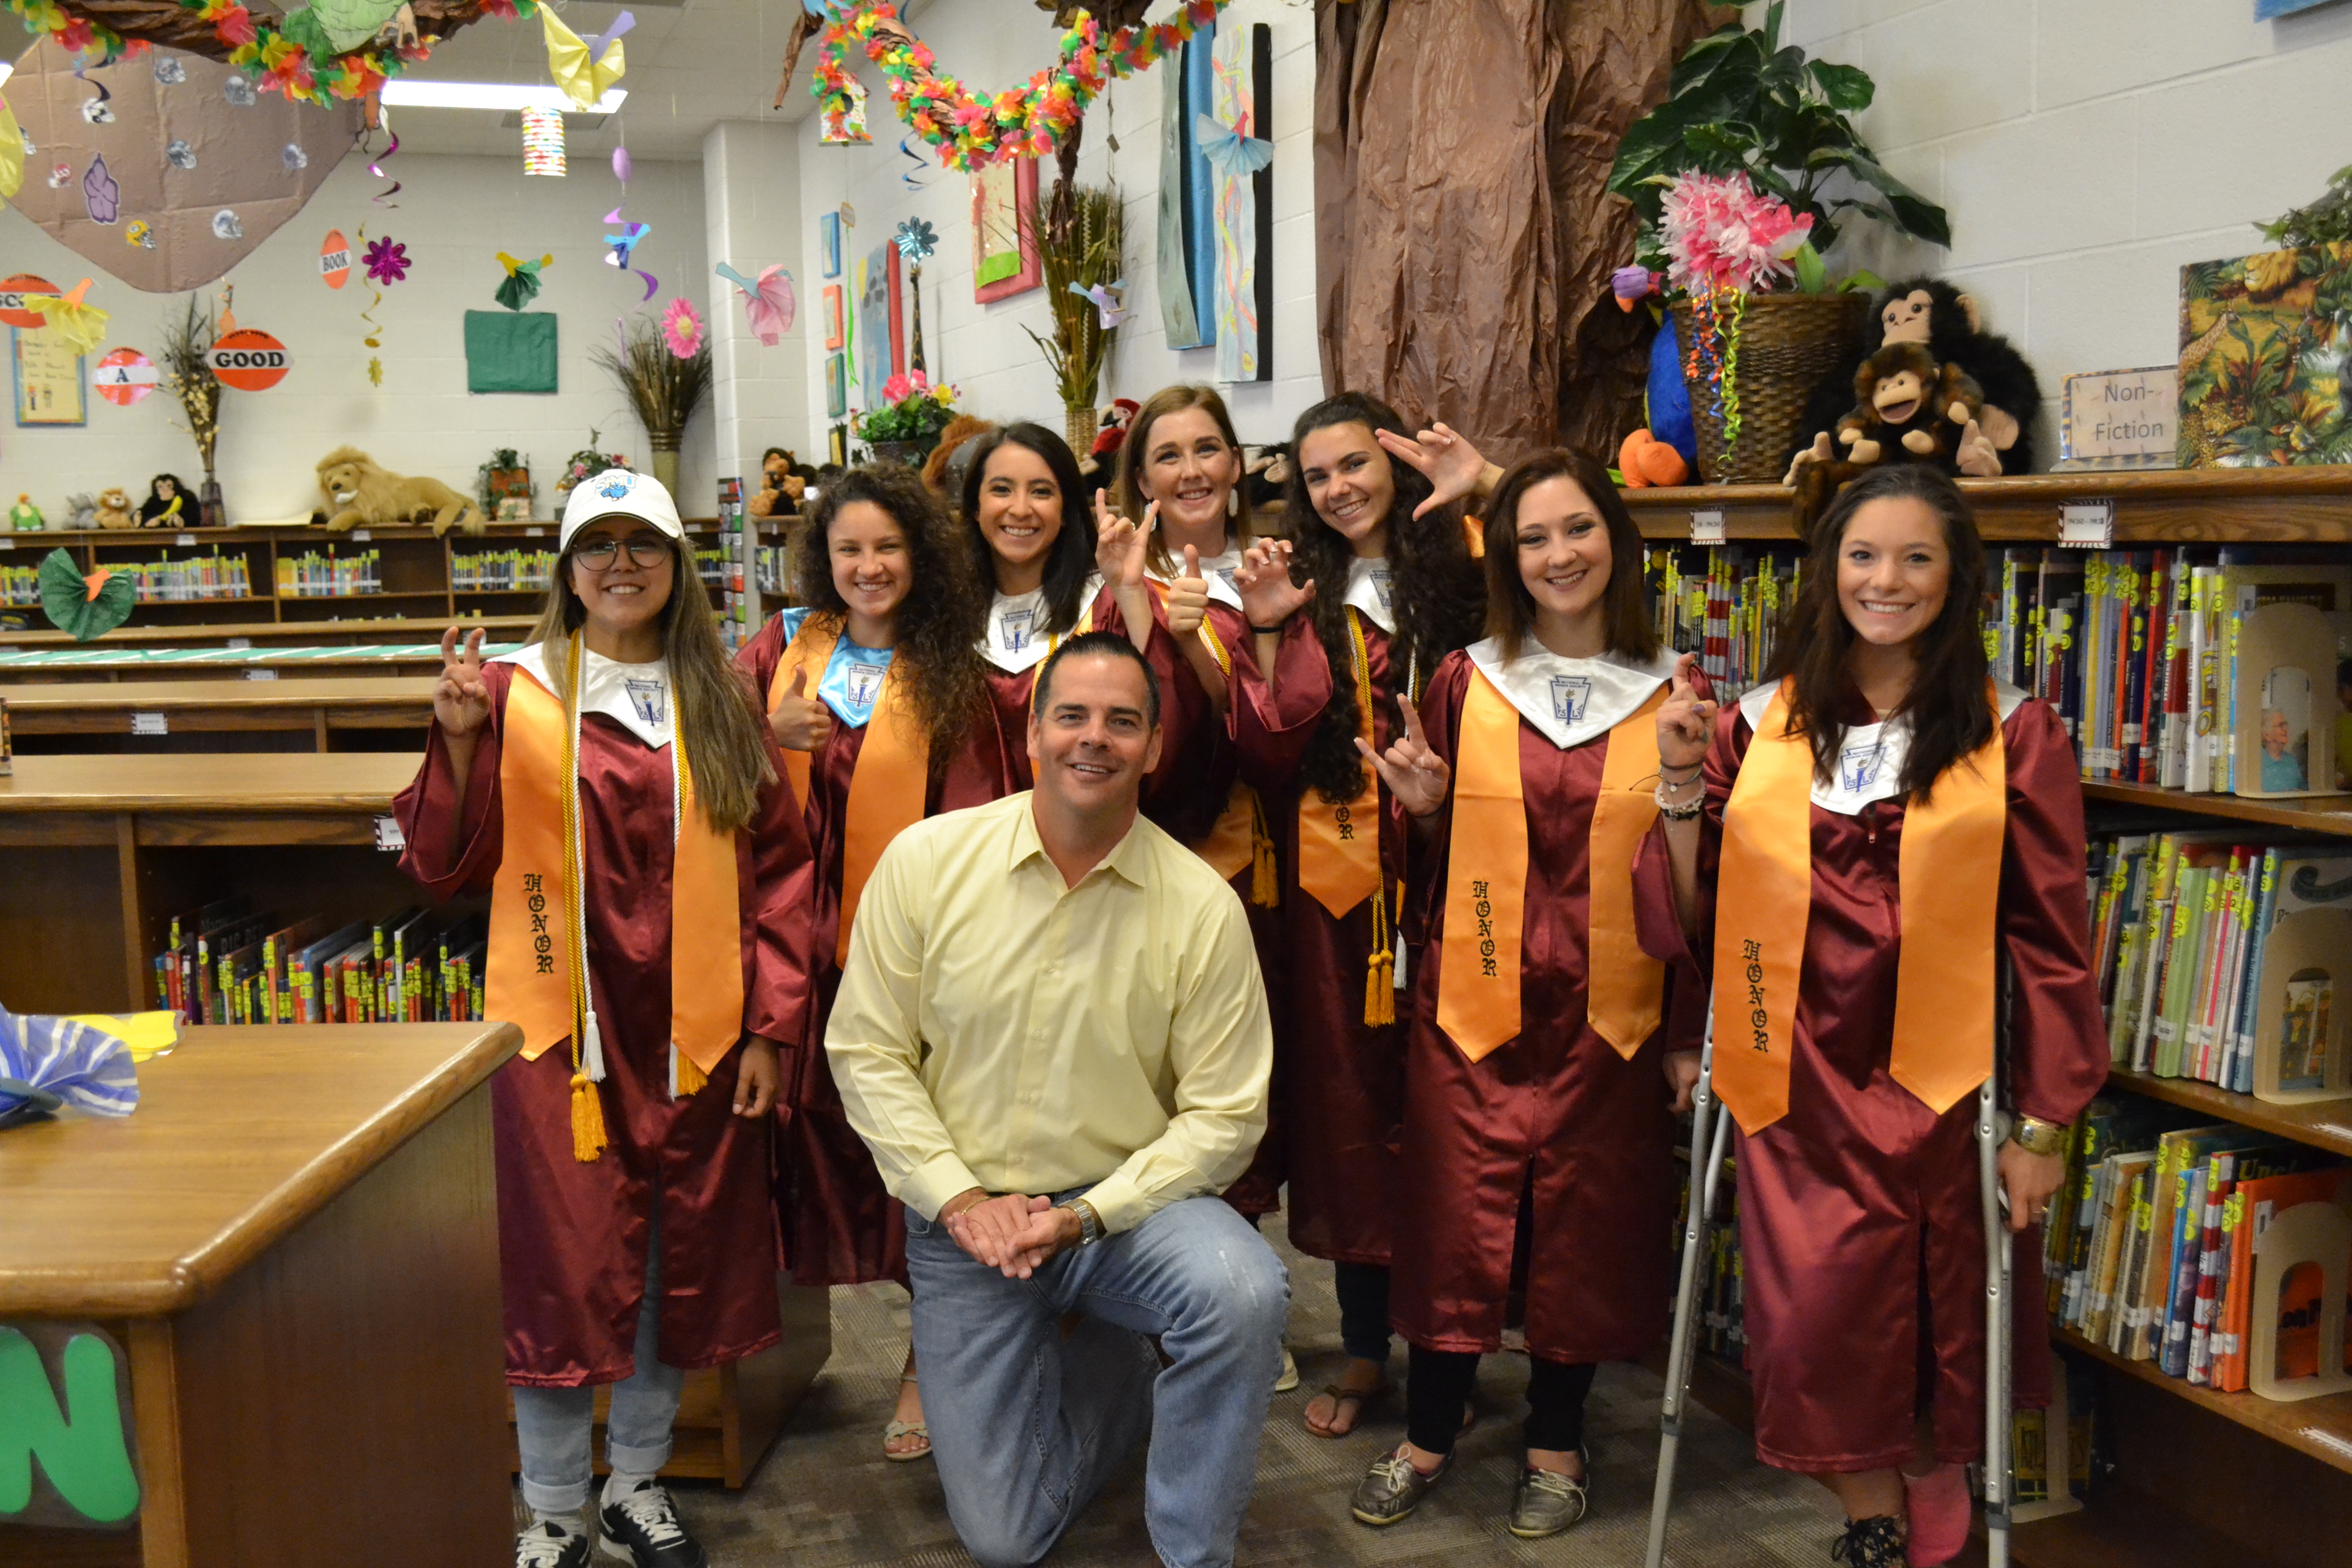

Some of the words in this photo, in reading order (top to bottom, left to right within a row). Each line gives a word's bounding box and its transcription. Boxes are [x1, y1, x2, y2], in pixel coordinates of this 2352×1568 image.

[323, 251, 348, 272] BOOK
[215, 352, 284, 368] GOOD
[115, 368, 129, 383] A
[2104, 383, 2154, 403] Non-
[2095, 420, 2163, 442] Fiction
[523, 873, 554, 974] HONOR
[1472, 880, 1498, 977] HONOR
[1742, 938, 1769, 1052] HONOR
[0, 1326, 139, 1522] N
